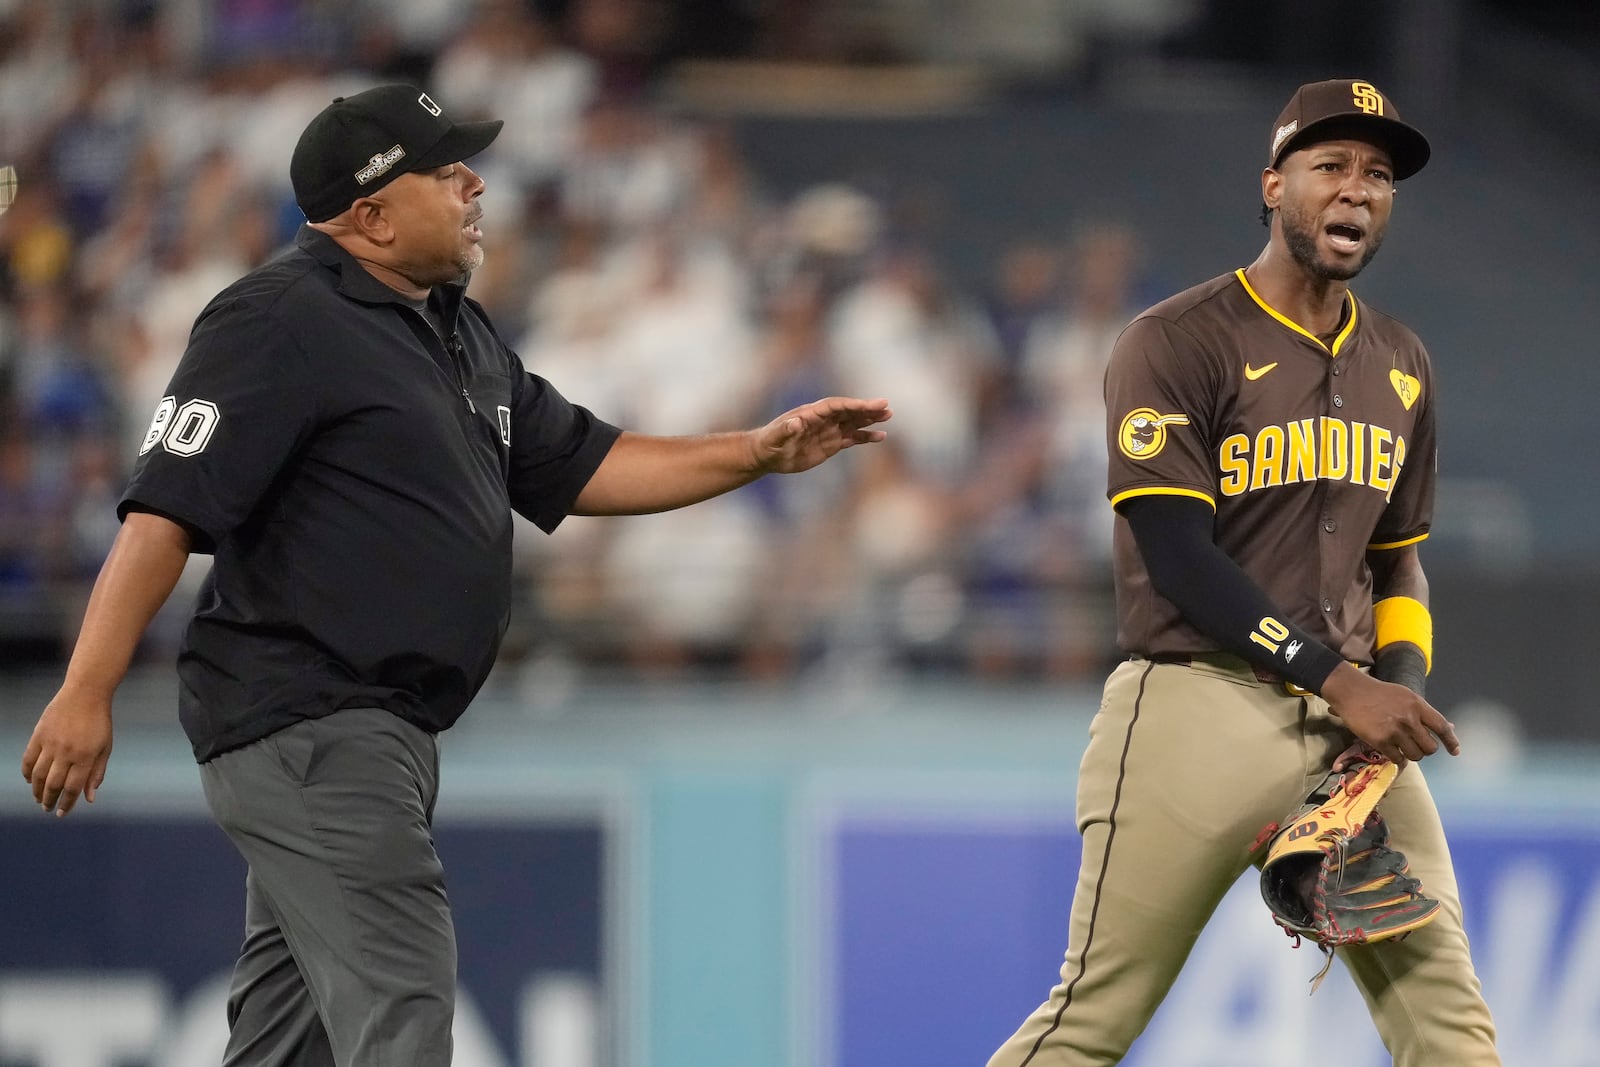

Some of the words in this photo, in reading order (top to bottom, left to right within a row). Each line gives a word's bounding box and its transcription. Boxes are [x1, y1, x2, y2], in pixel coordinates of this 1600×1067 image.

[1351, 81, 1384, 117] SD
[357, 147, 403, 183] POSTSEASON
[1399, 378, 1411, 401] PS
[1219, 417, 1318, 497] SAN
[1249, 616, 1290, 655] 10
